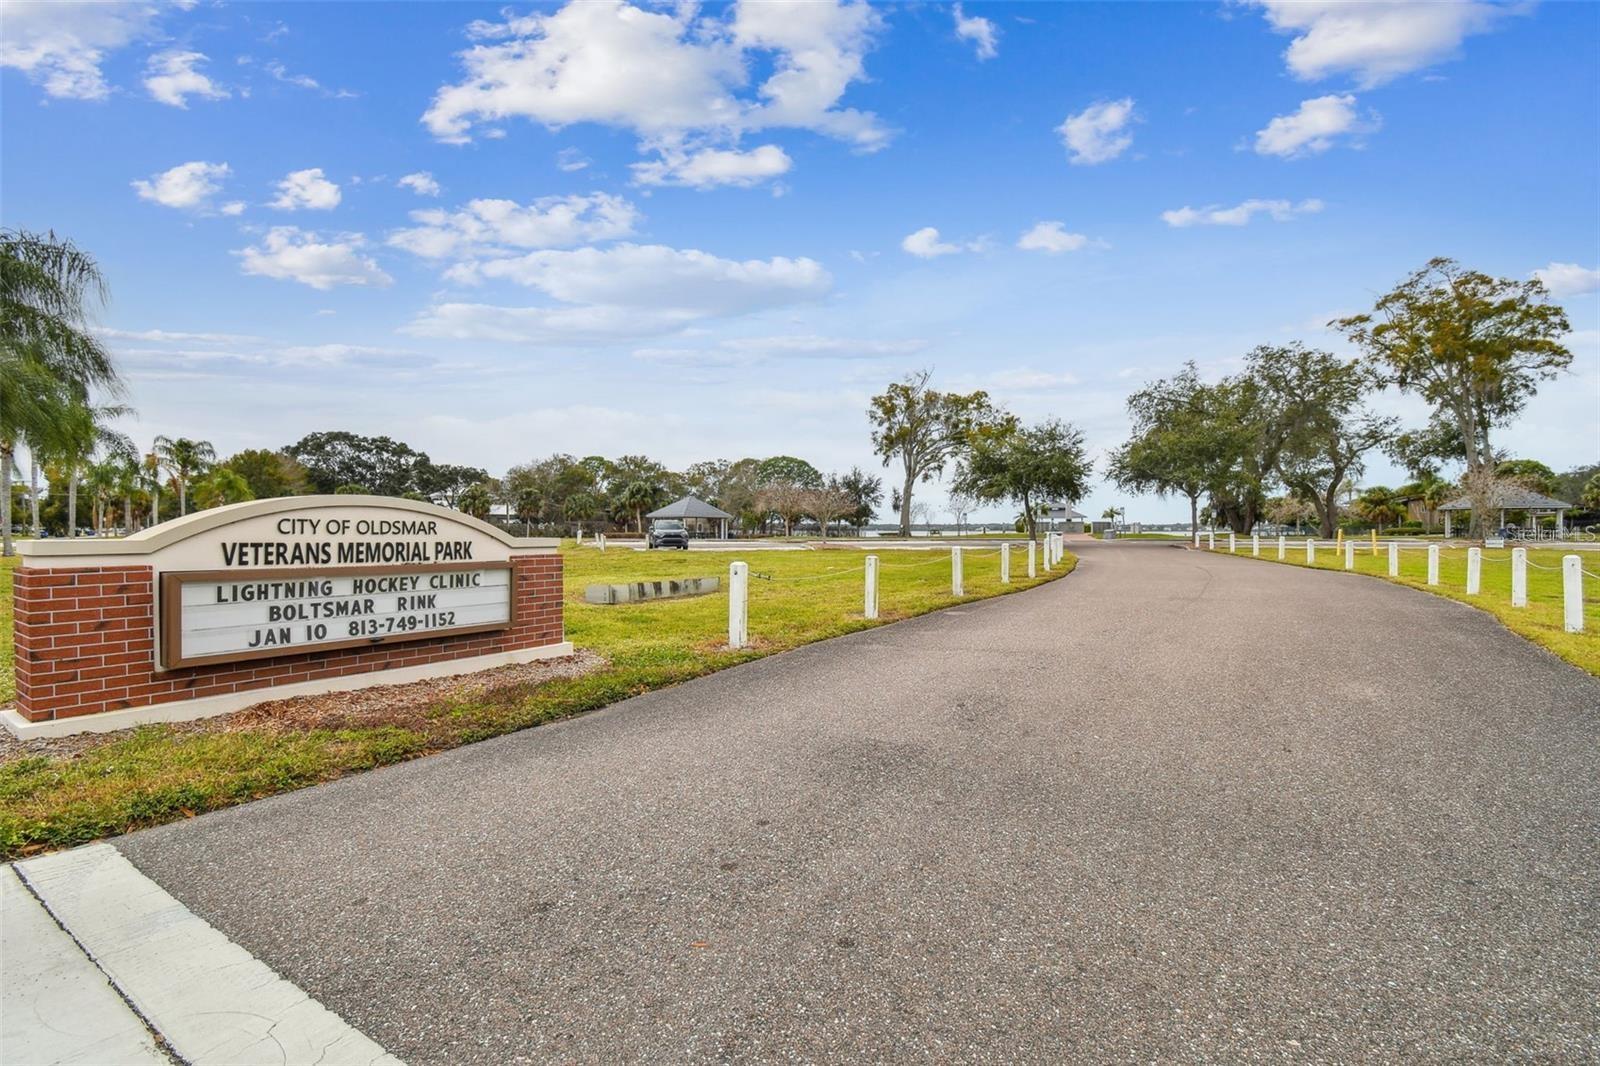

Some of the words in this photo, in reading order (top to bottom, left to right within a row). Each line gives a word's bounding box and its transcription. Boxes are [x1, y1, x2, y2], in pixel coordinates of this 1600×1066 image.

[277, 518, 321, 535] CITY
[326, 519, 350, 535] OF
[356, 520, 438, 535] OLDSMAR
[221, 541, 332, 566] VETERANS
[337, 541, 431, 563] MEMORIAL
[434, 541, 473, 560] PARK
[217, 580, 332, 603] LIGHTNING
[353, 576, 420, 594] HOCKEY
[429, 573, 480, 589] CLINIC
[269, 599, 375, 622] BOLTSMAR
[397, 594, 437, 611] RINK
[248, 627, 291, 647] JAN
[306, 624, 327, 641] 10
[348, 611, 456, 636] 813-749-1152
